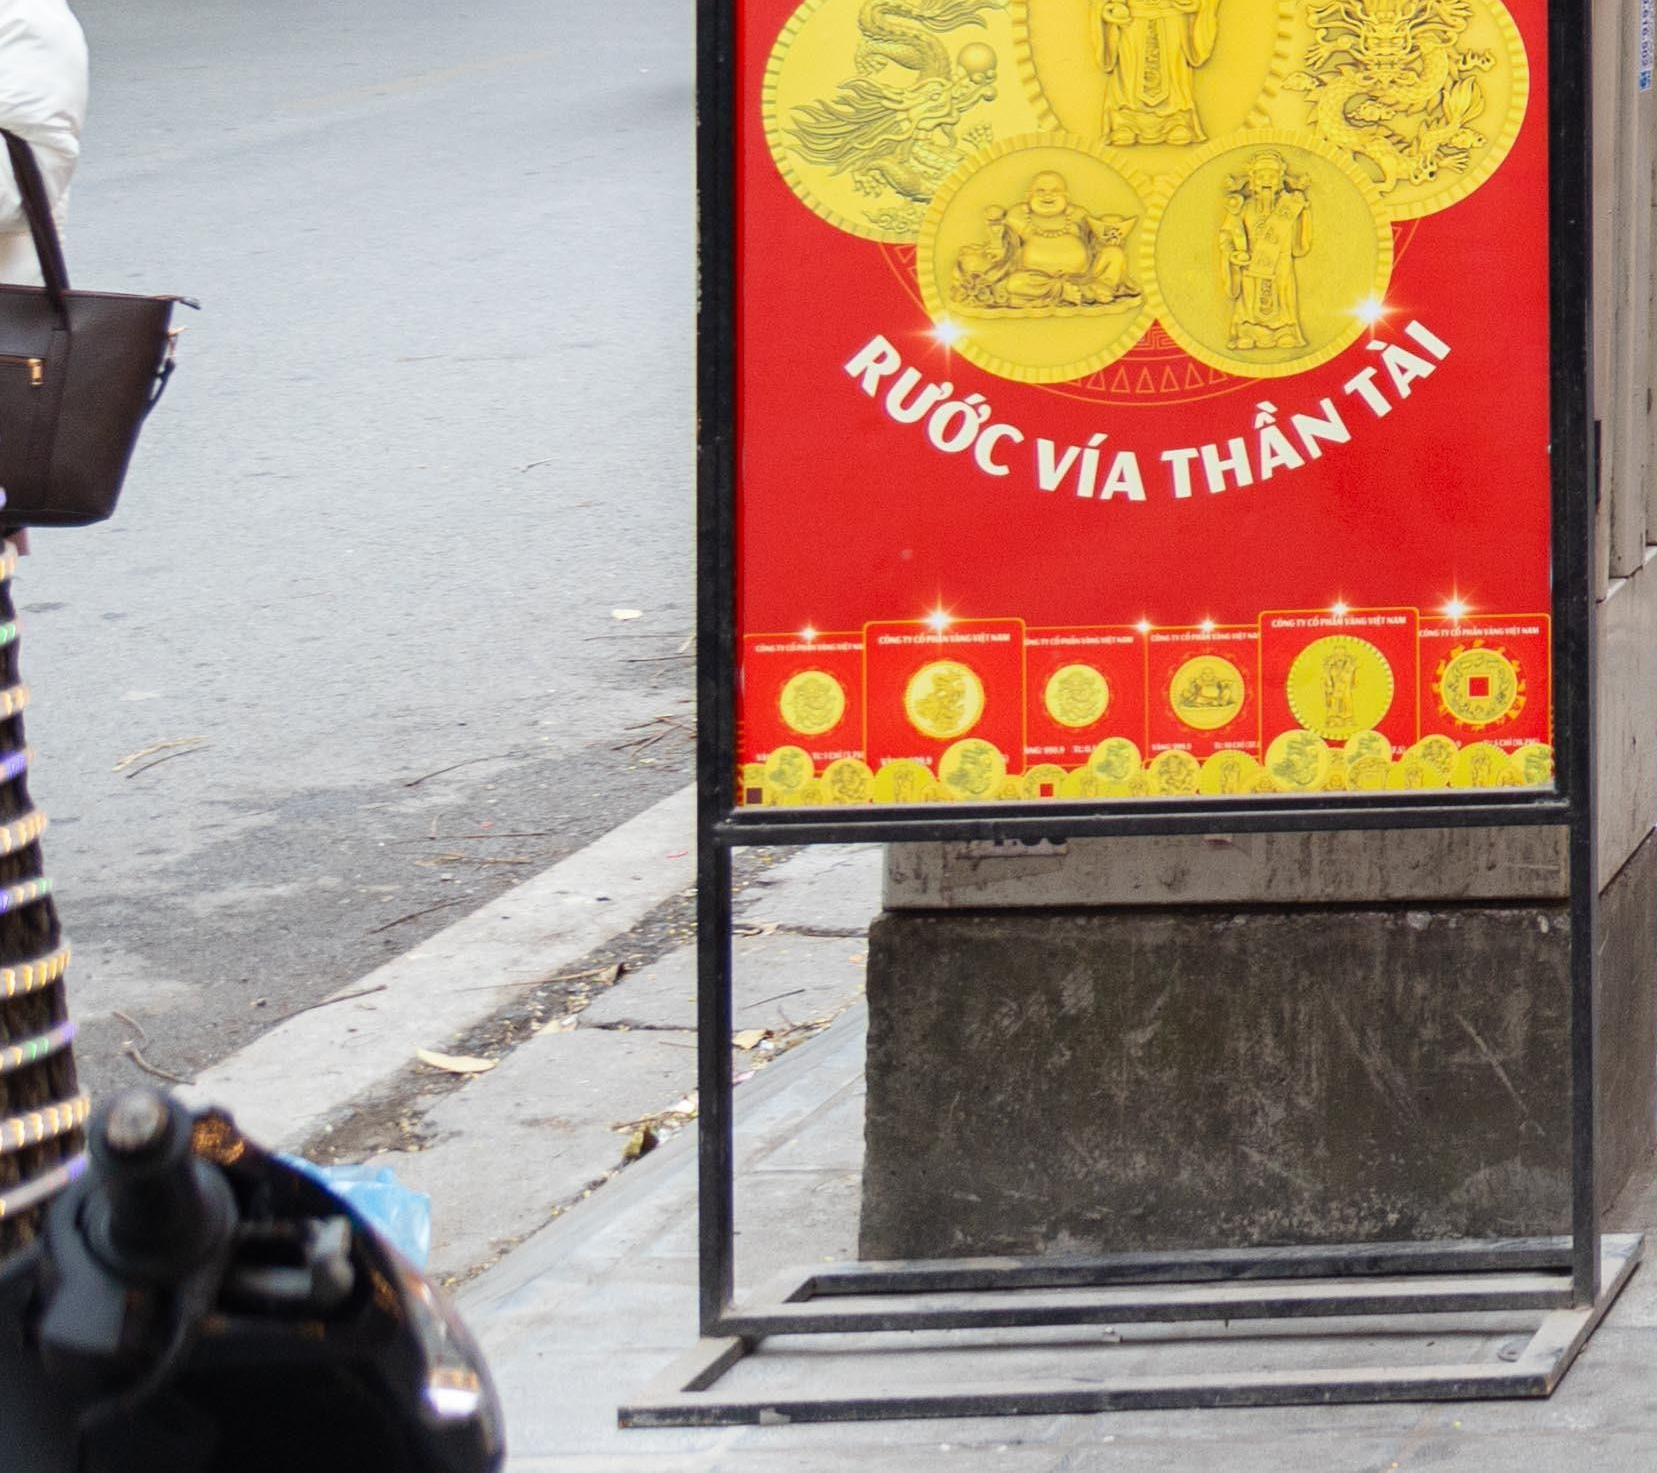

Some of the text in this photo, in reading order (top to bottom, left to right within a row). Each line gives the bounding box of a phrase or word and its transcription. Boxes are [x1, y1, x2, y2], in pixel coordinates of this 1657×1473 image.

[842, 318, 1454, 502] RƯỚC VÍA THẦN TÀI
